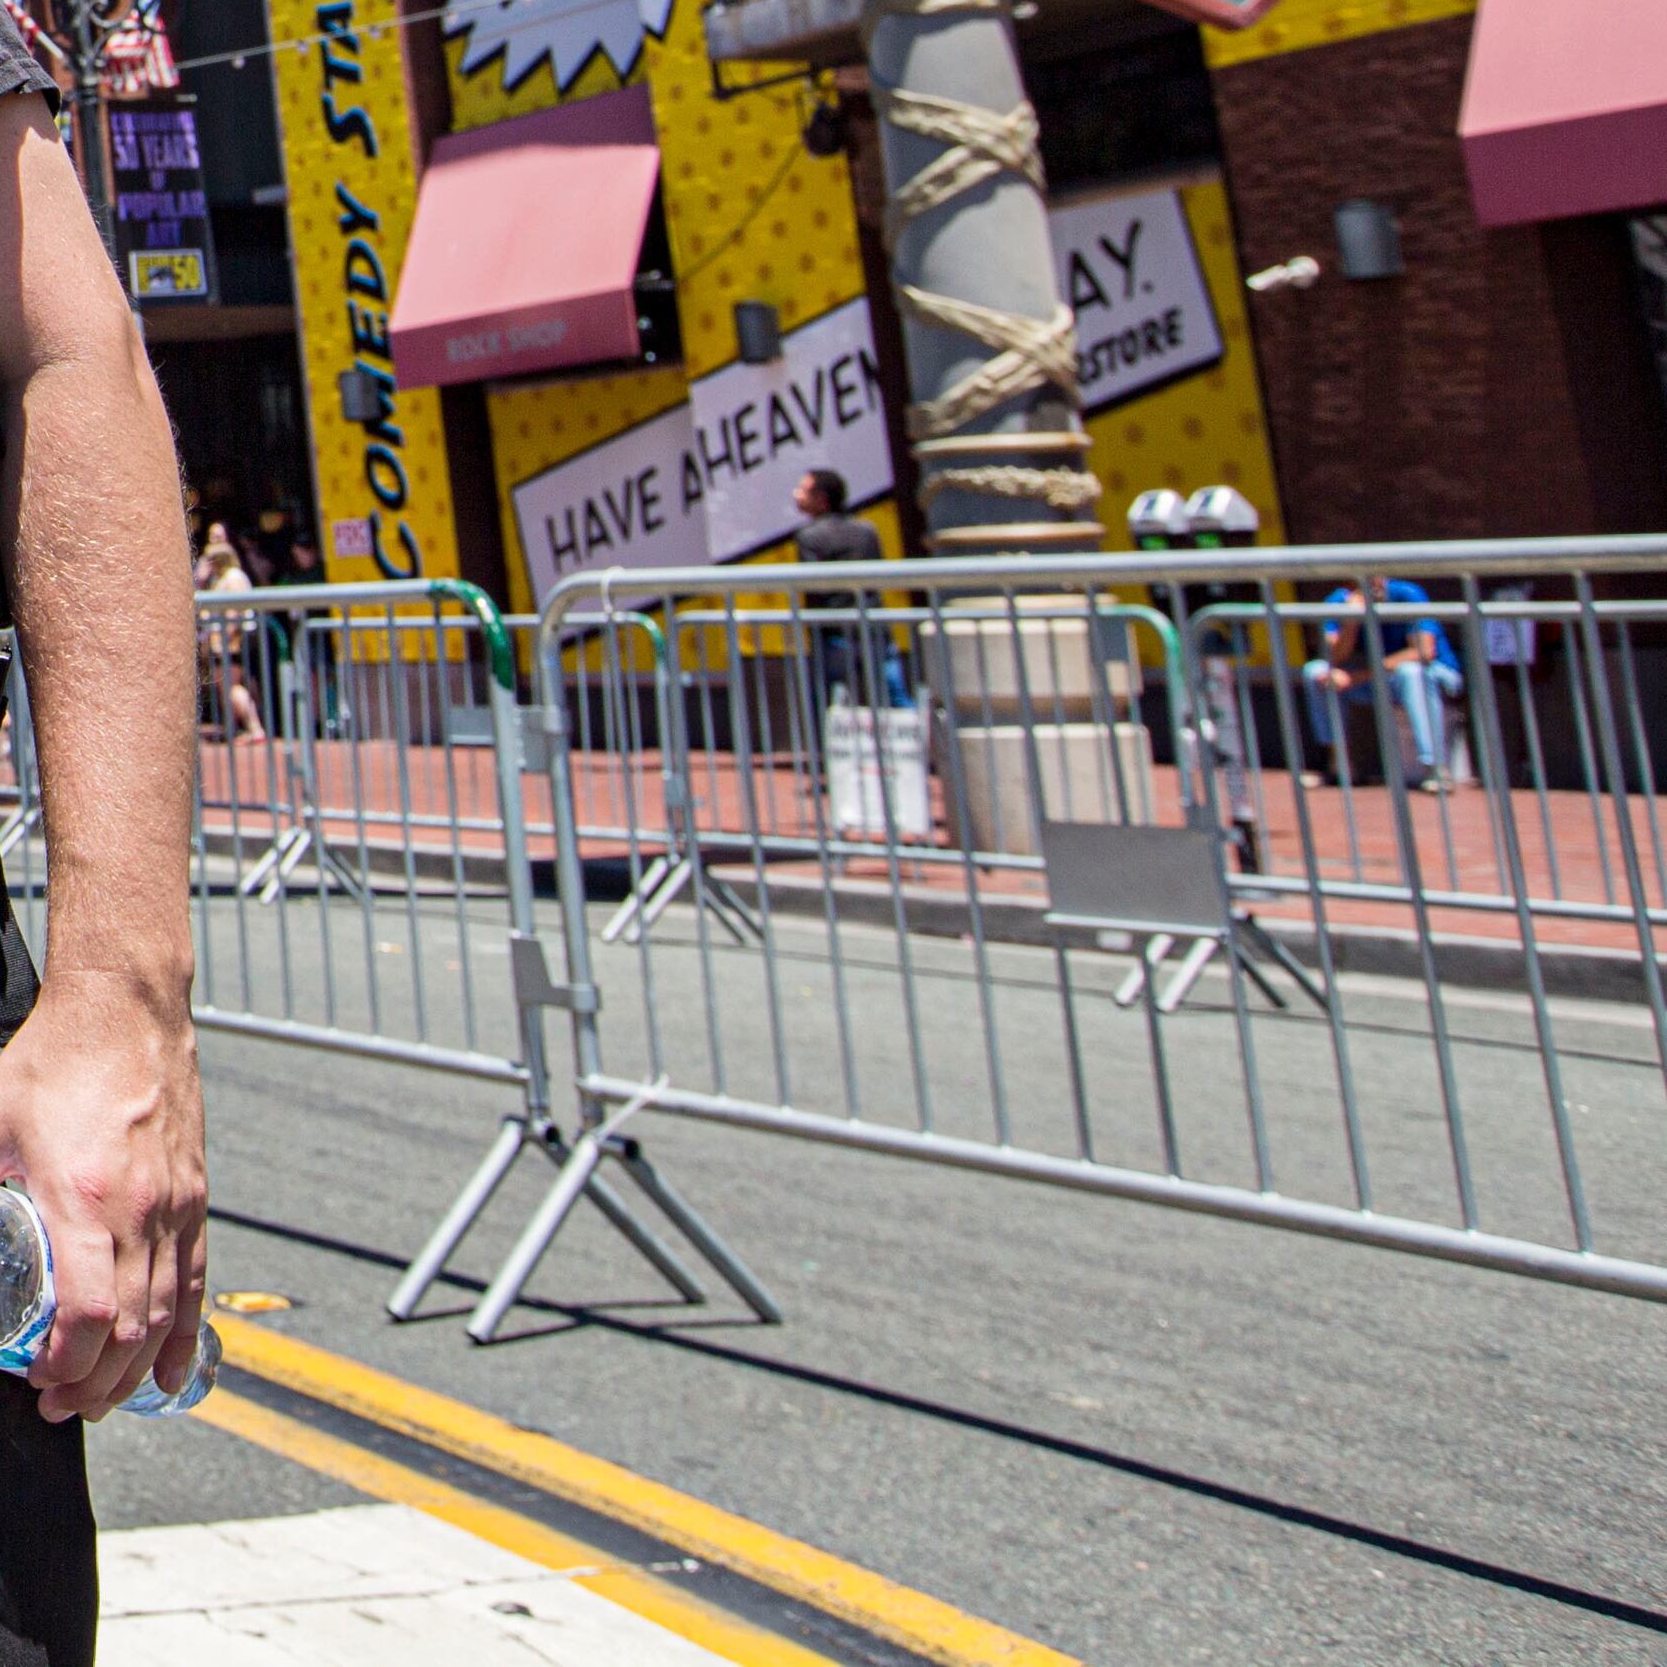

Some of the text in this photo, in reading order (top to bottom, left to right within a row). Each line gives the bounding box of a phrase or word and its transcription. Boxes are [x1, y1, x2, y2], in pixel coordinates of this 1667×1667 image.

[1067, 217, 1154, 321] AY.
[335, 179, 424, 581] COMEDY
[545, 465, 665, 573] HAVE
